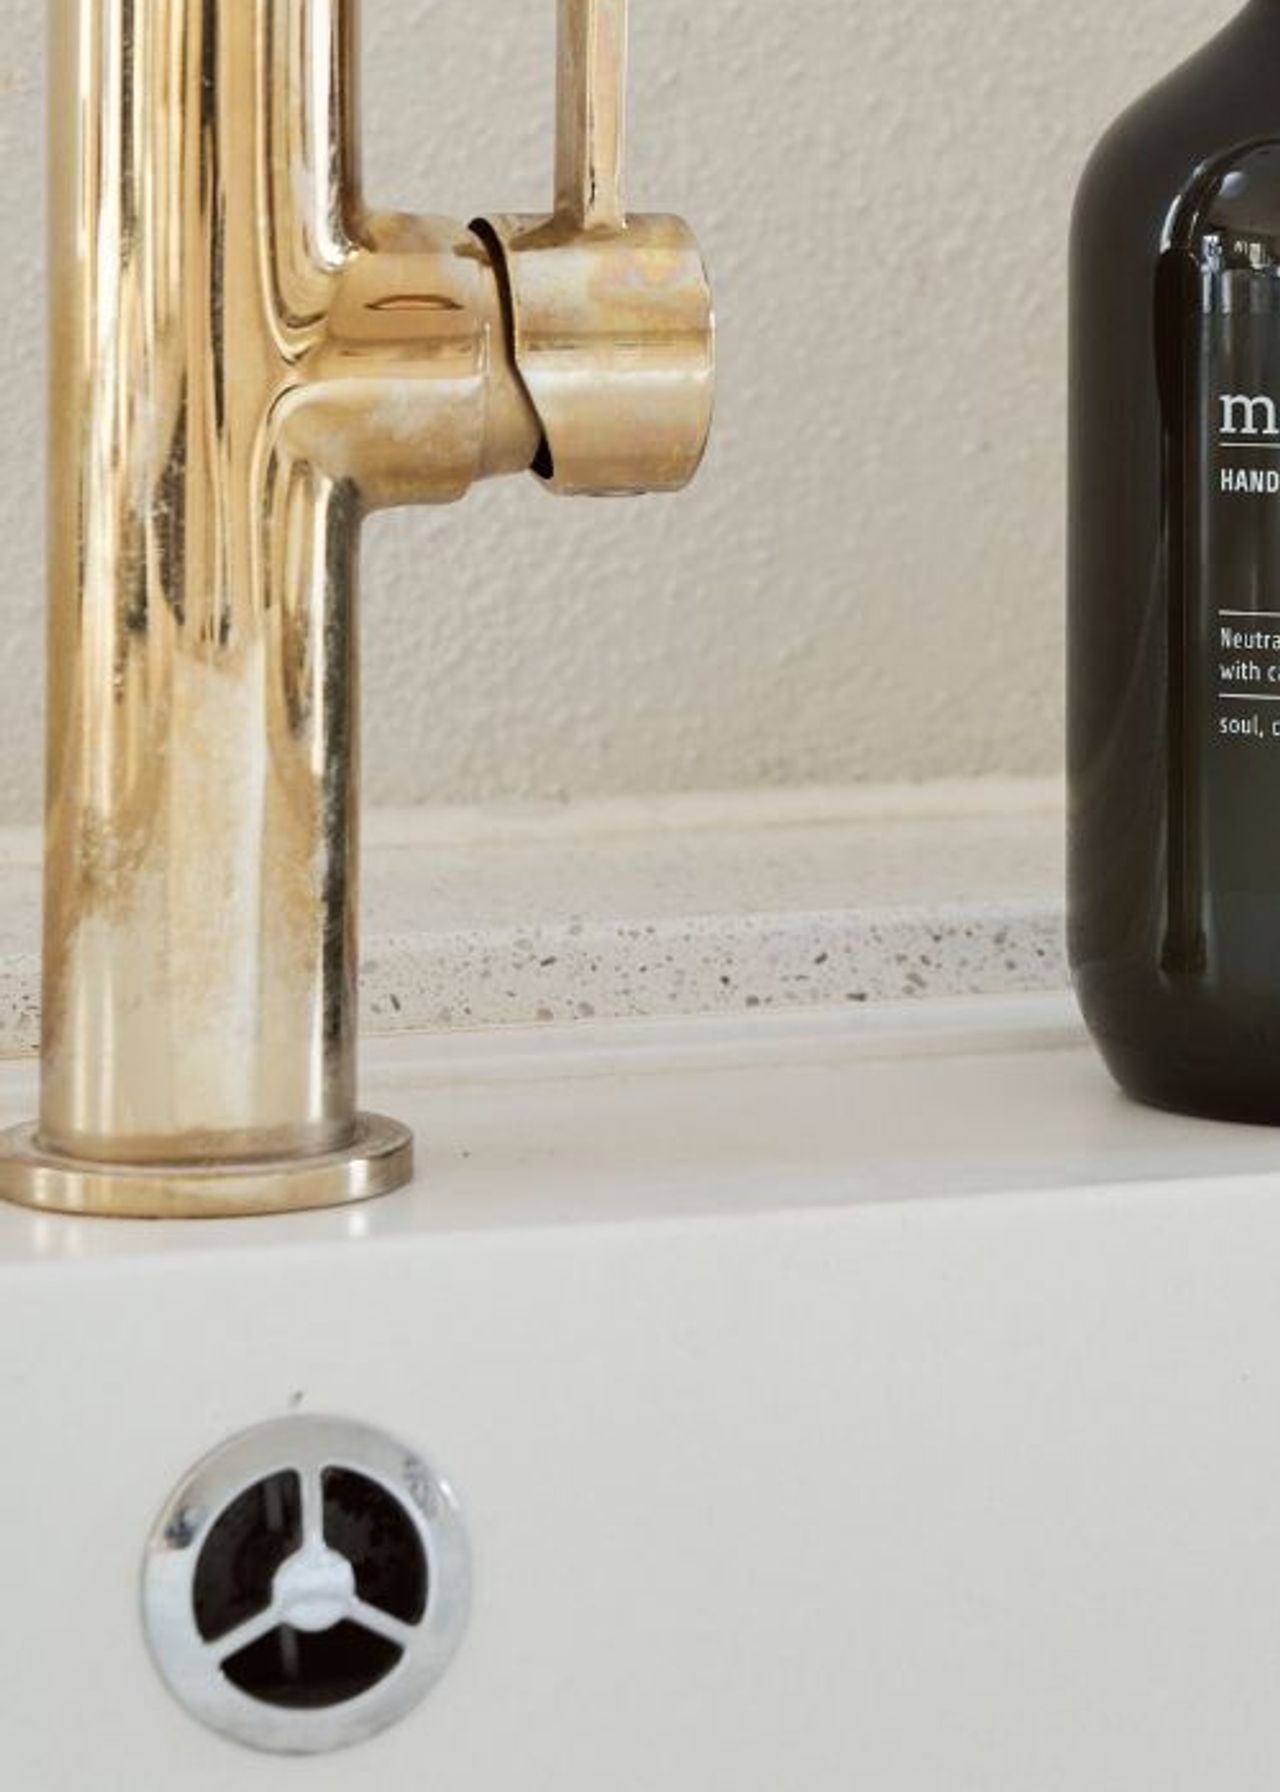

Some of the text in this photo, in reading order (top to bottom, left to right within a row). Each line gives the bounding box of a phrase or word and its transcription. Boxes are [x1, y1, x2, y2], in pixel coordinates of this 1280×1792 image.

[1219, 468, 1280, 494] HAND
[1218, 660, 1262, 682] with
[1218, 714, 1265, 740] soul,
